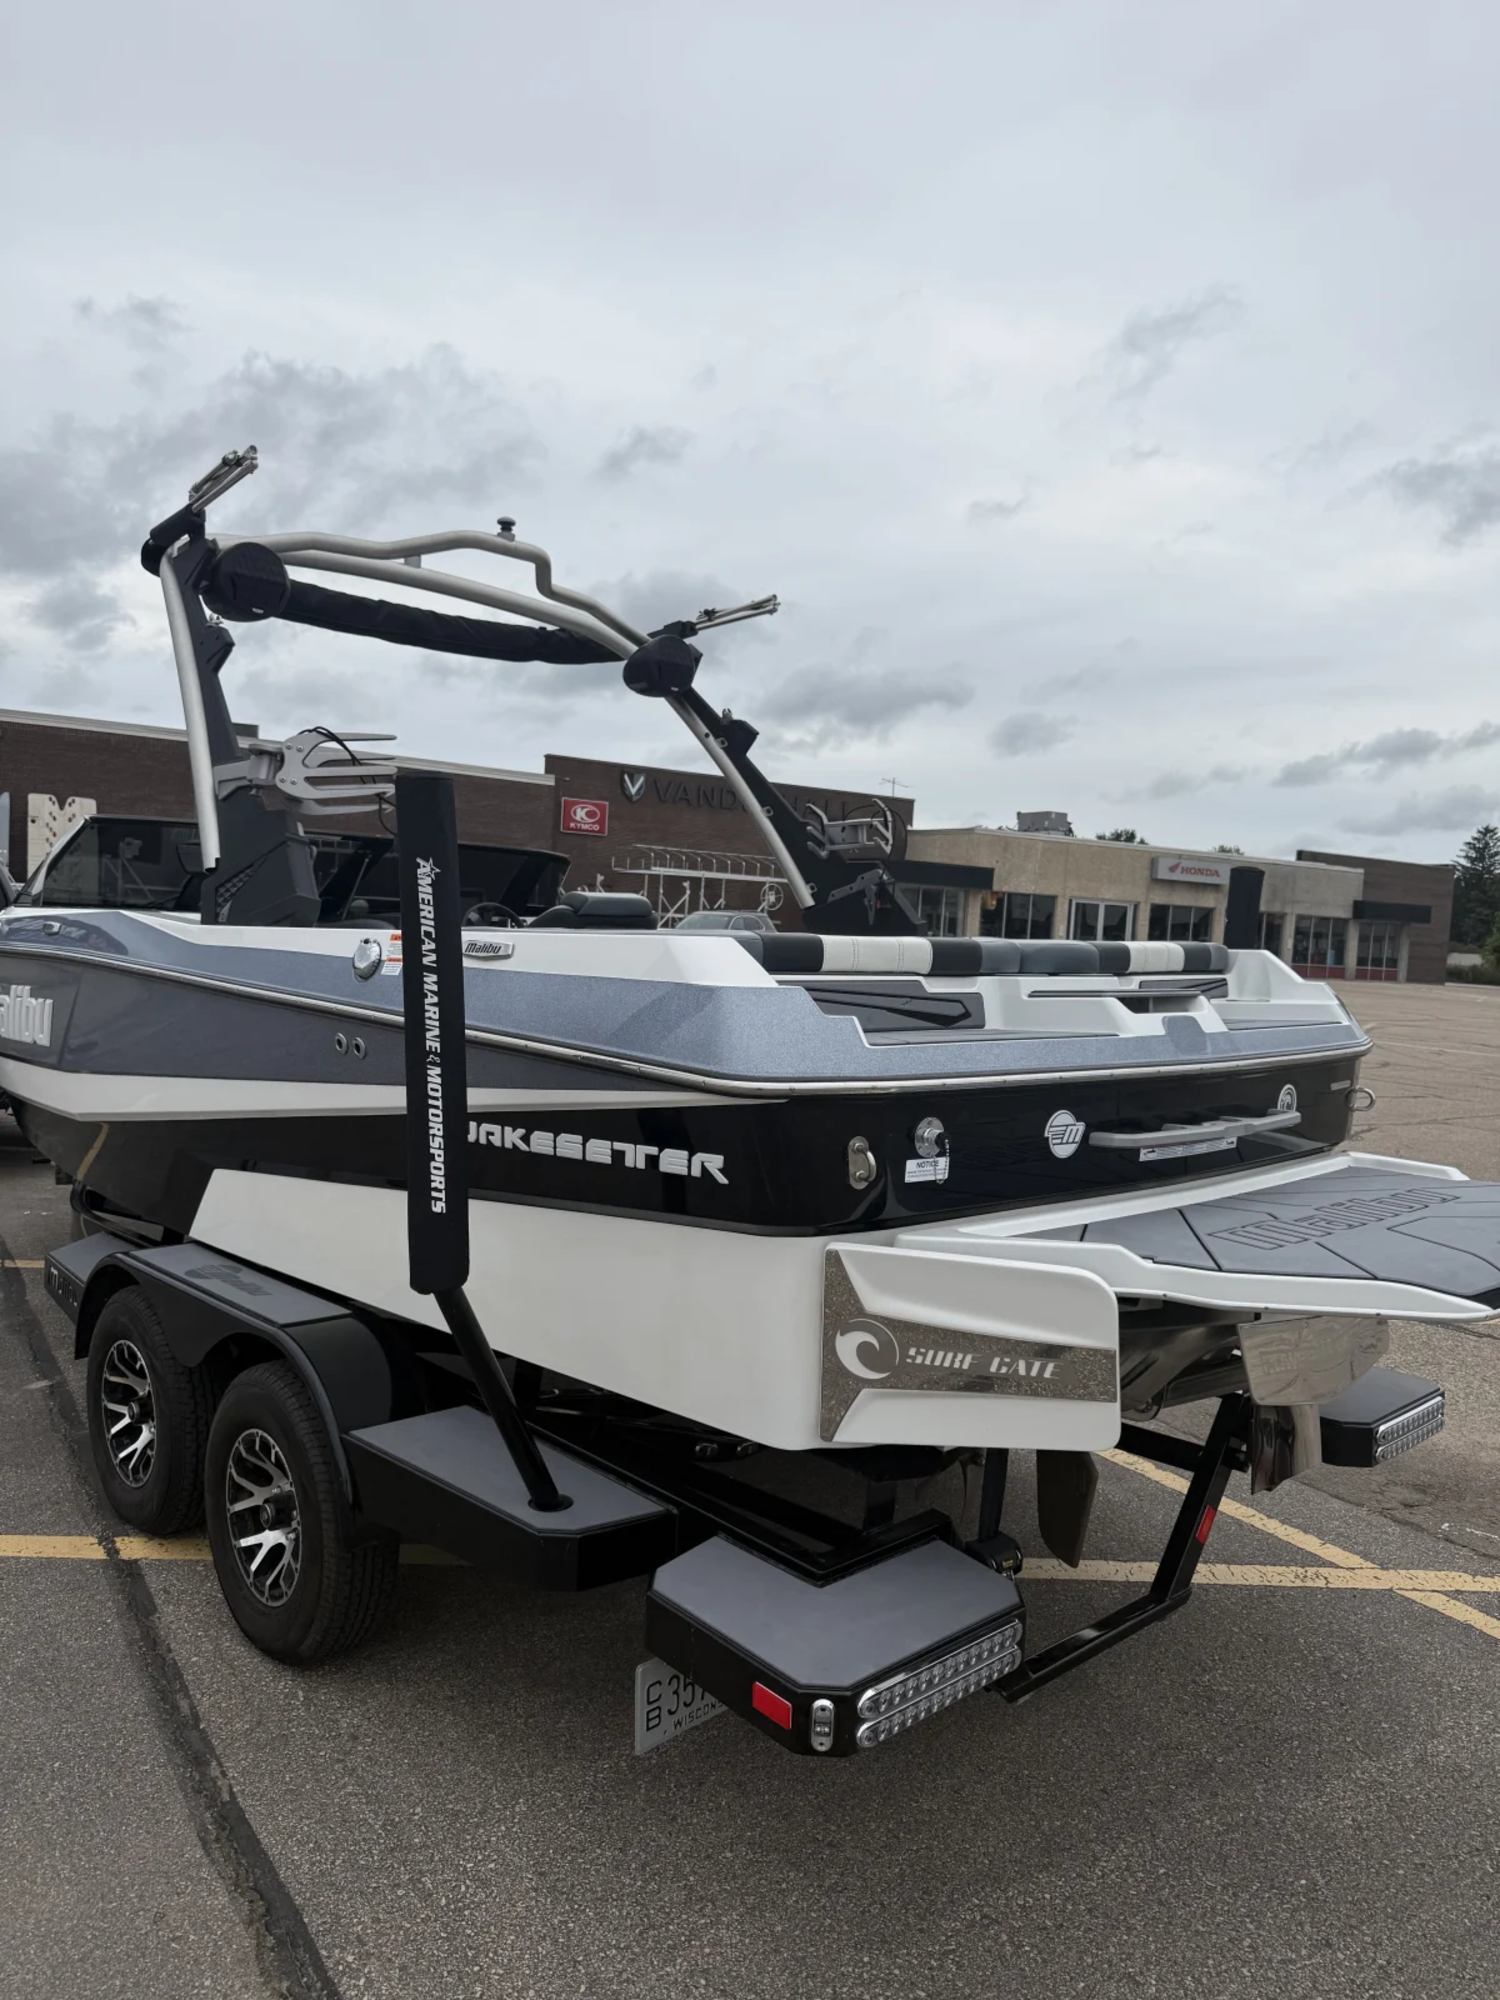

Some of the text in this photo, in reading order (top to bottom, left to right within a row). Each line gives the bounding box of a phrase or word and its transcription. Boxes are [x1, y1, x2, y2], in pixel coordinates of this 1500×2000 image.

[653, 778, 848, 821] VANDHALL
[570, 822, 600, 831] KYMCO
[1180, 866, 1221, 878] HONDA
[0, 984, 54, 1047] alibu
[416, 857, 446, 1214] AMERICAN MARINE & MOTORSPORTS
[906, 1347, 1064, 1380] SURF GATE
[667, 1674, 706, 1716] 35
[673, 1700, 724, 1731] WISCONS
